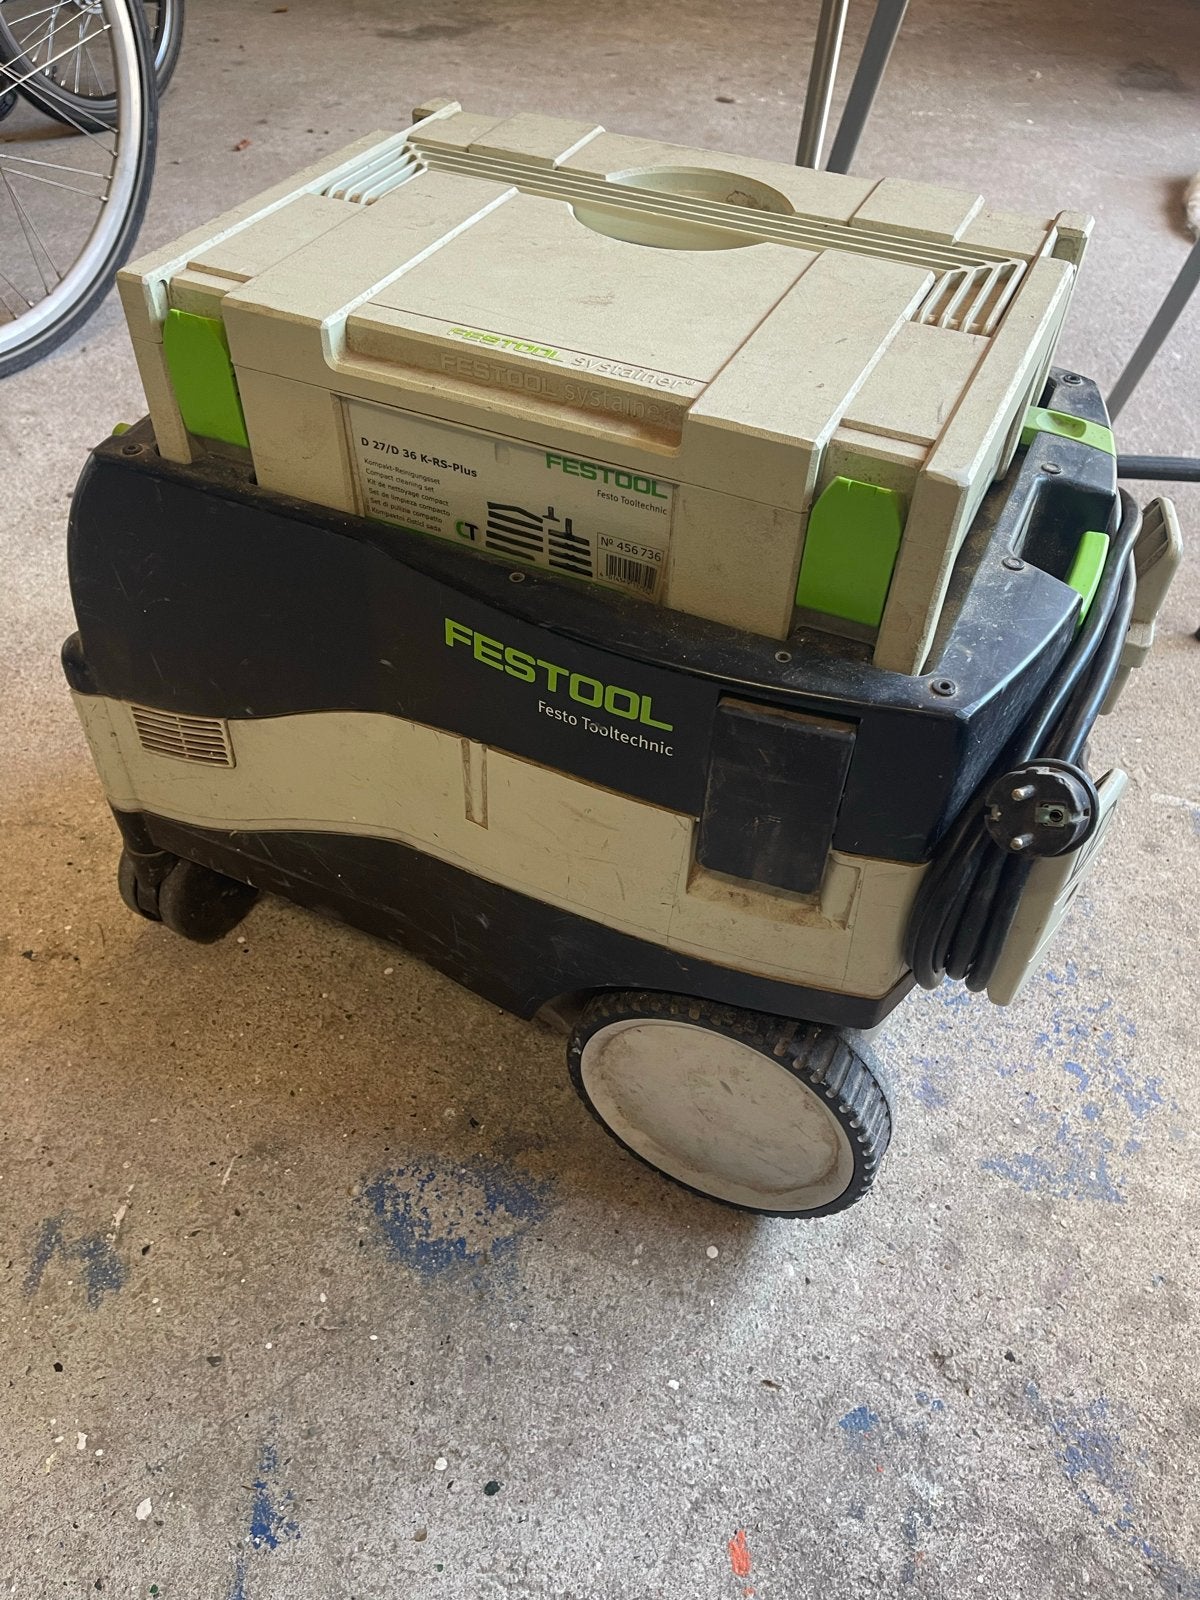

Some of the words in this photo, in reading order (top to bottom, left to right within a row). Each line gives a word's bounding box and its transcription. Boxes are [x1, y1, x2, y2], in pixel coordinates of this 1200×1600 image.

[448, 328, 564, 363] FESTOOL
[440, 353, 559, 397] FESTOOL
[361, 437, 368, 446] D
[373, 441, 399, 455] 27/D
[403, 449, 417, 460] 36
[421, 454, 477, 478] K-RS-Plus
[364, 458, 440, 484] Kompakt-Reinigungsset
[366, 468, 393, 480] Compact
[396, 476, 422, 491] cleaning
[546, 452, 668, 499] FESTOOL
[369, 487, 379, 495] Set
[391, 493, 417, 507] limpieza
[419, 503, 450, 516] compacto
[388, 484, 419, 498] nettoyage
[421, 494, 449, 506] compact
[597, 489, 618, 502] Festo
[621, 496, 667, 515] Tooltechnic
[456, 522, 478, 540] CT
[445, 618, 673, 731] FESTOOL
[538, 700, 578, 726] Festo
[581, 716, 673, 756] Tooltechnic
